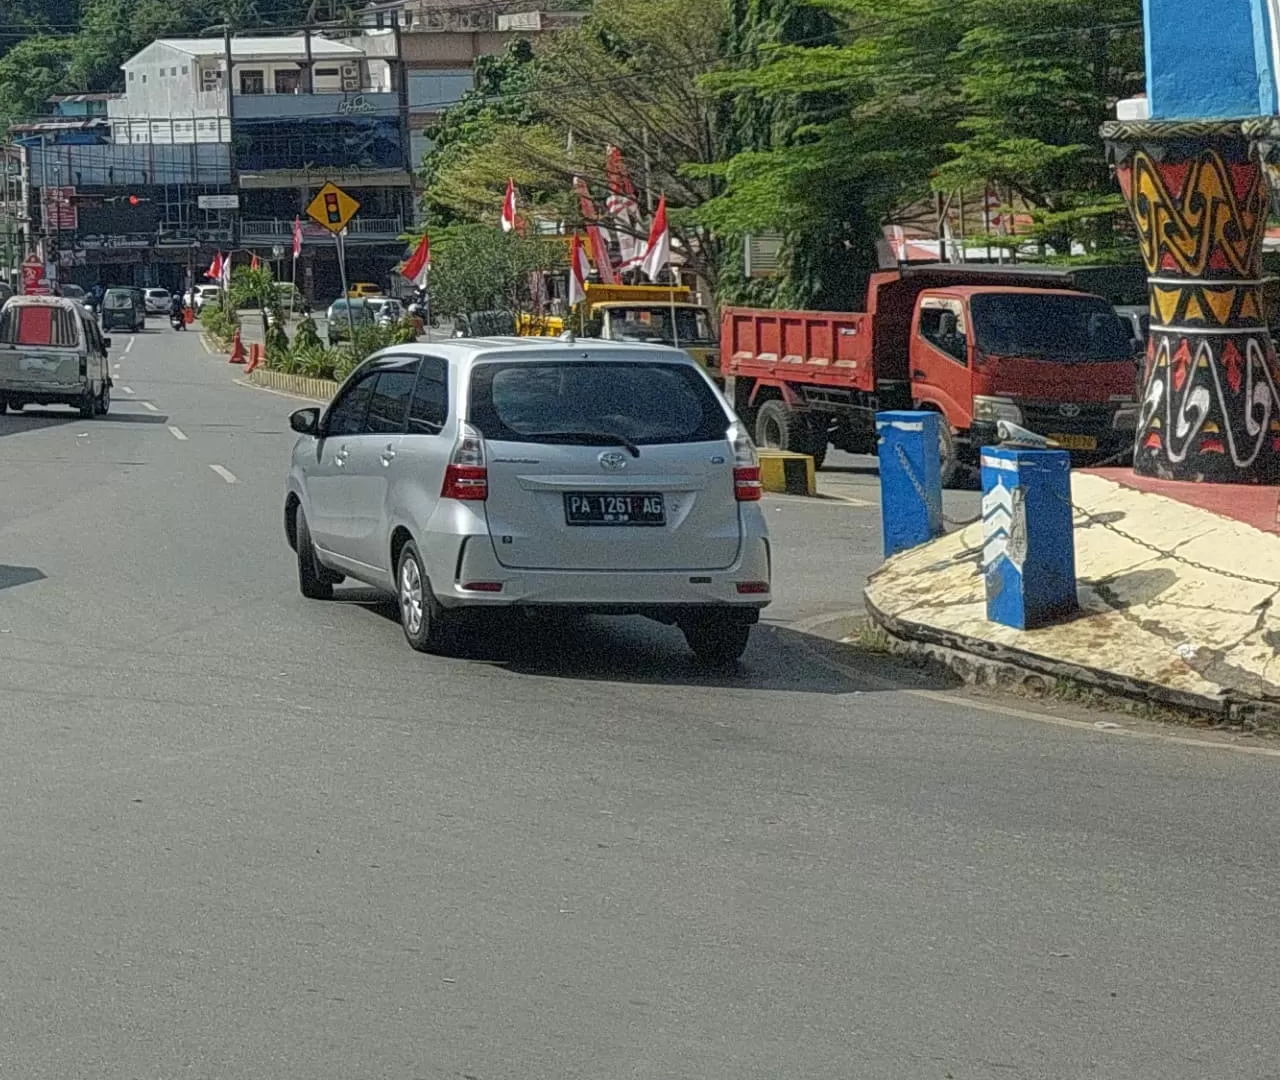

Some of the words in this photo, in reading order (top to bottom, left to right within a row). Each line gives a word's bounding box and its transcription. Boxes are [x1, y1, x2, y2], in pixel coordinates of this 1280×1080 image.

[571, 496, 591, 513] PA
[599, 497, 633, 514] 1261
[642, 497, 661, 514] AG
